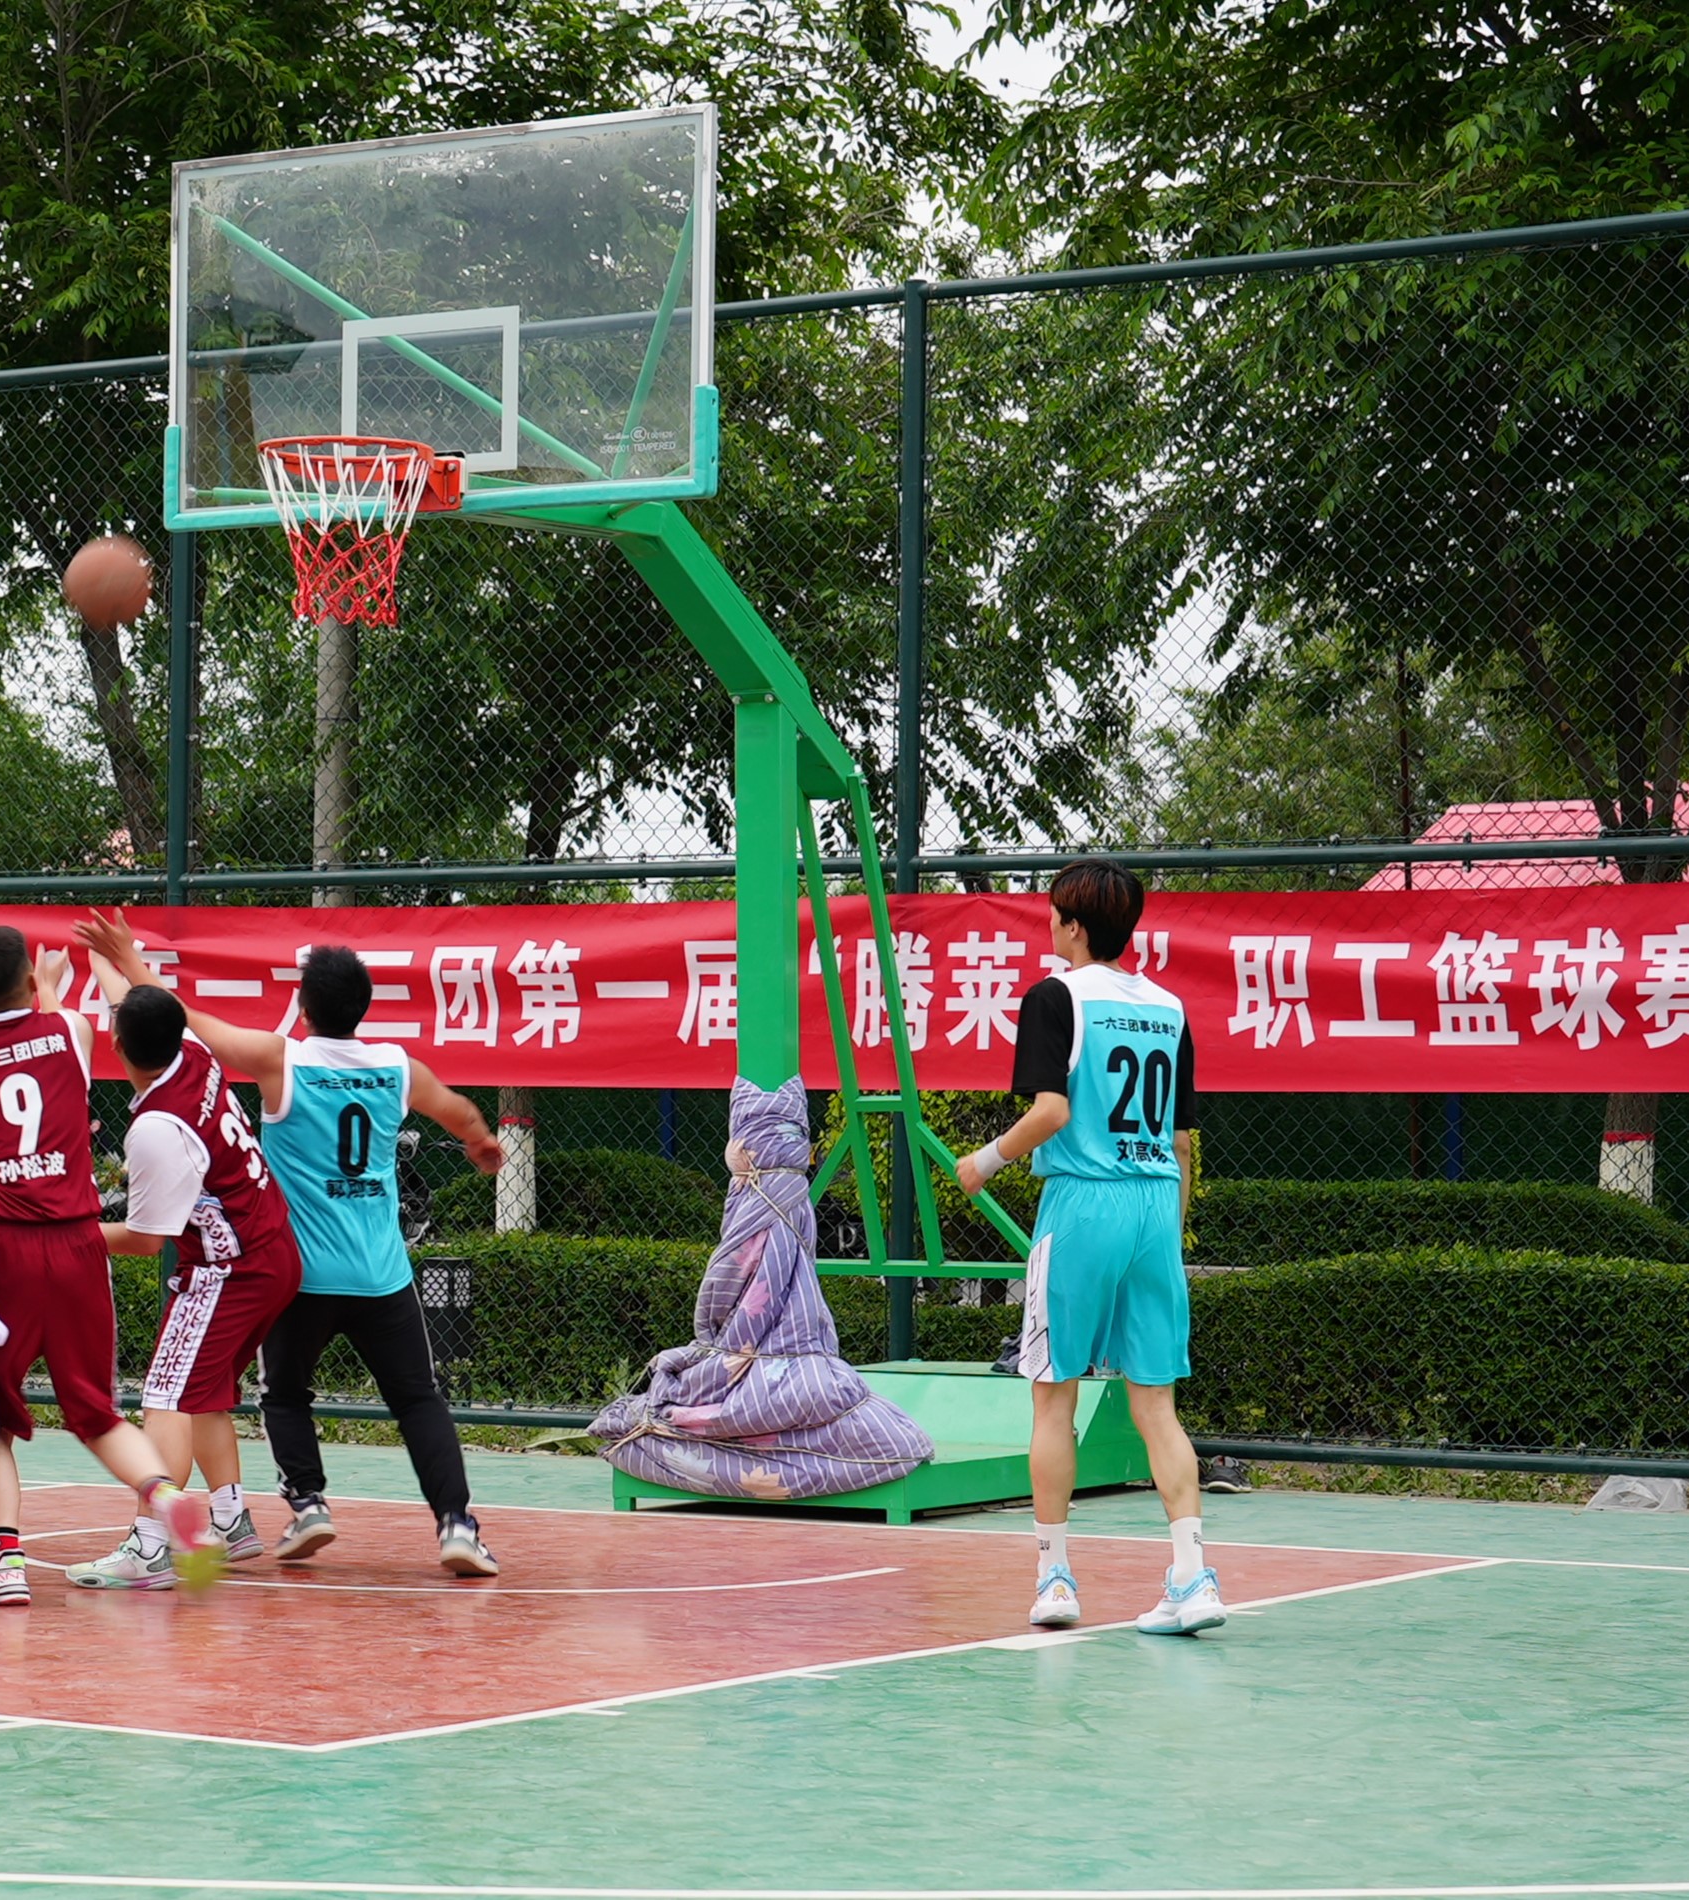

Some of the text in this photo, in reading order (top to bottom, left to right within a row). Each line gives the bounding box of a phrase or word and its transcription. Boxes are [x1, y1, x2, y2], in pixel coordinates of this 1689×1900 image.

[634, 441, 676, 452] TEMPERED
[1093, 1017, 1177, 1038] 一六三团事业单位
[0, 1072, 43, 1156] 9
[1107, 1045, 1172, 1137] 20
[338, 1102, 371, 1178] 0
